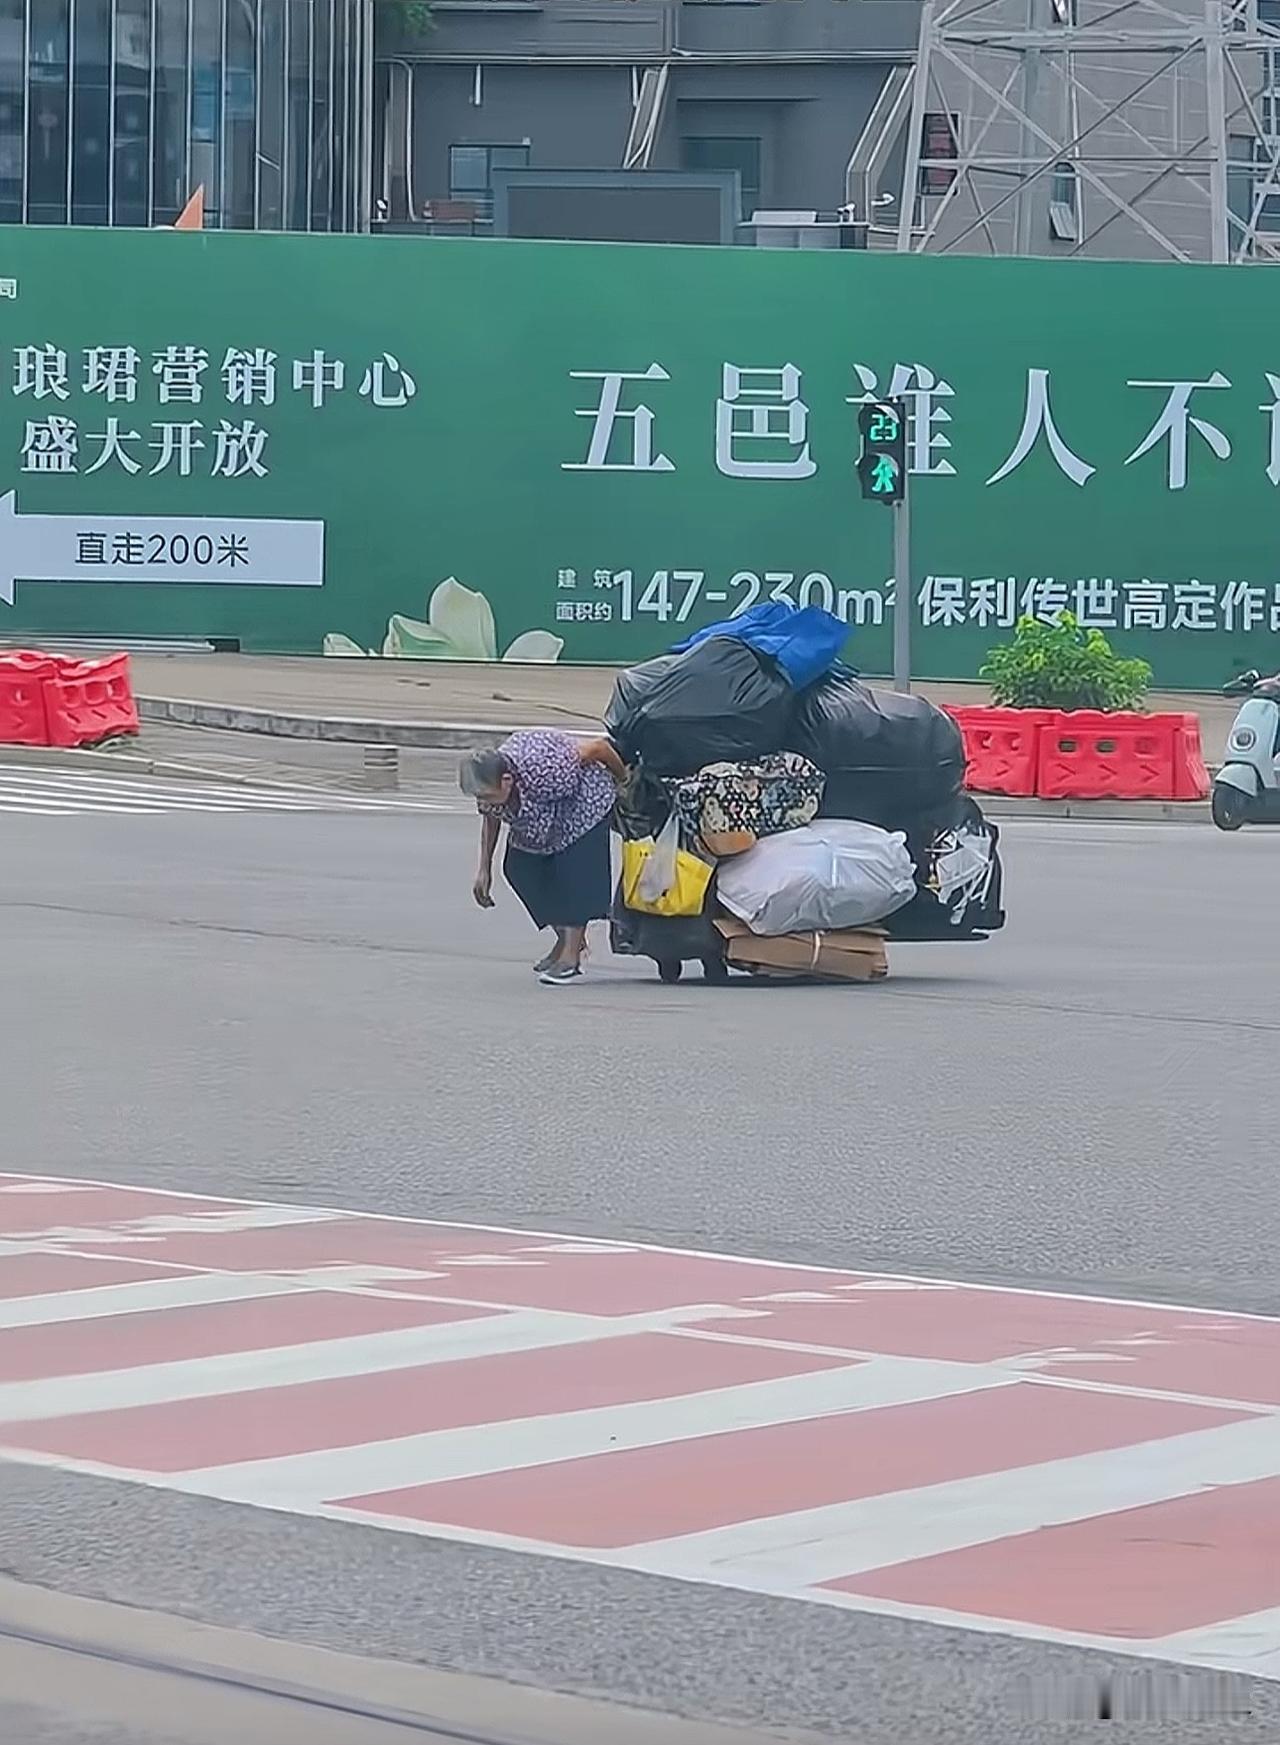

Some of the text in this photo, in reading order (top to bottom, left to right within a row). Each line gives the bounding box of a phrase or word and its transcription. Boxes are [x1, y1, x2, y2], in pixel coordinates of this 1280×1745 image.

[12, 343, 417, 408] 琅珺营销中心
[20, 415, 270, 478] 盛大开放
[870, 414, 897, 441] 23
[74, 532, 250, 568] 直走200米
[556, 601, 613, 622] 面积约
[917, 575, 1280, 632] 保利传世高定作
